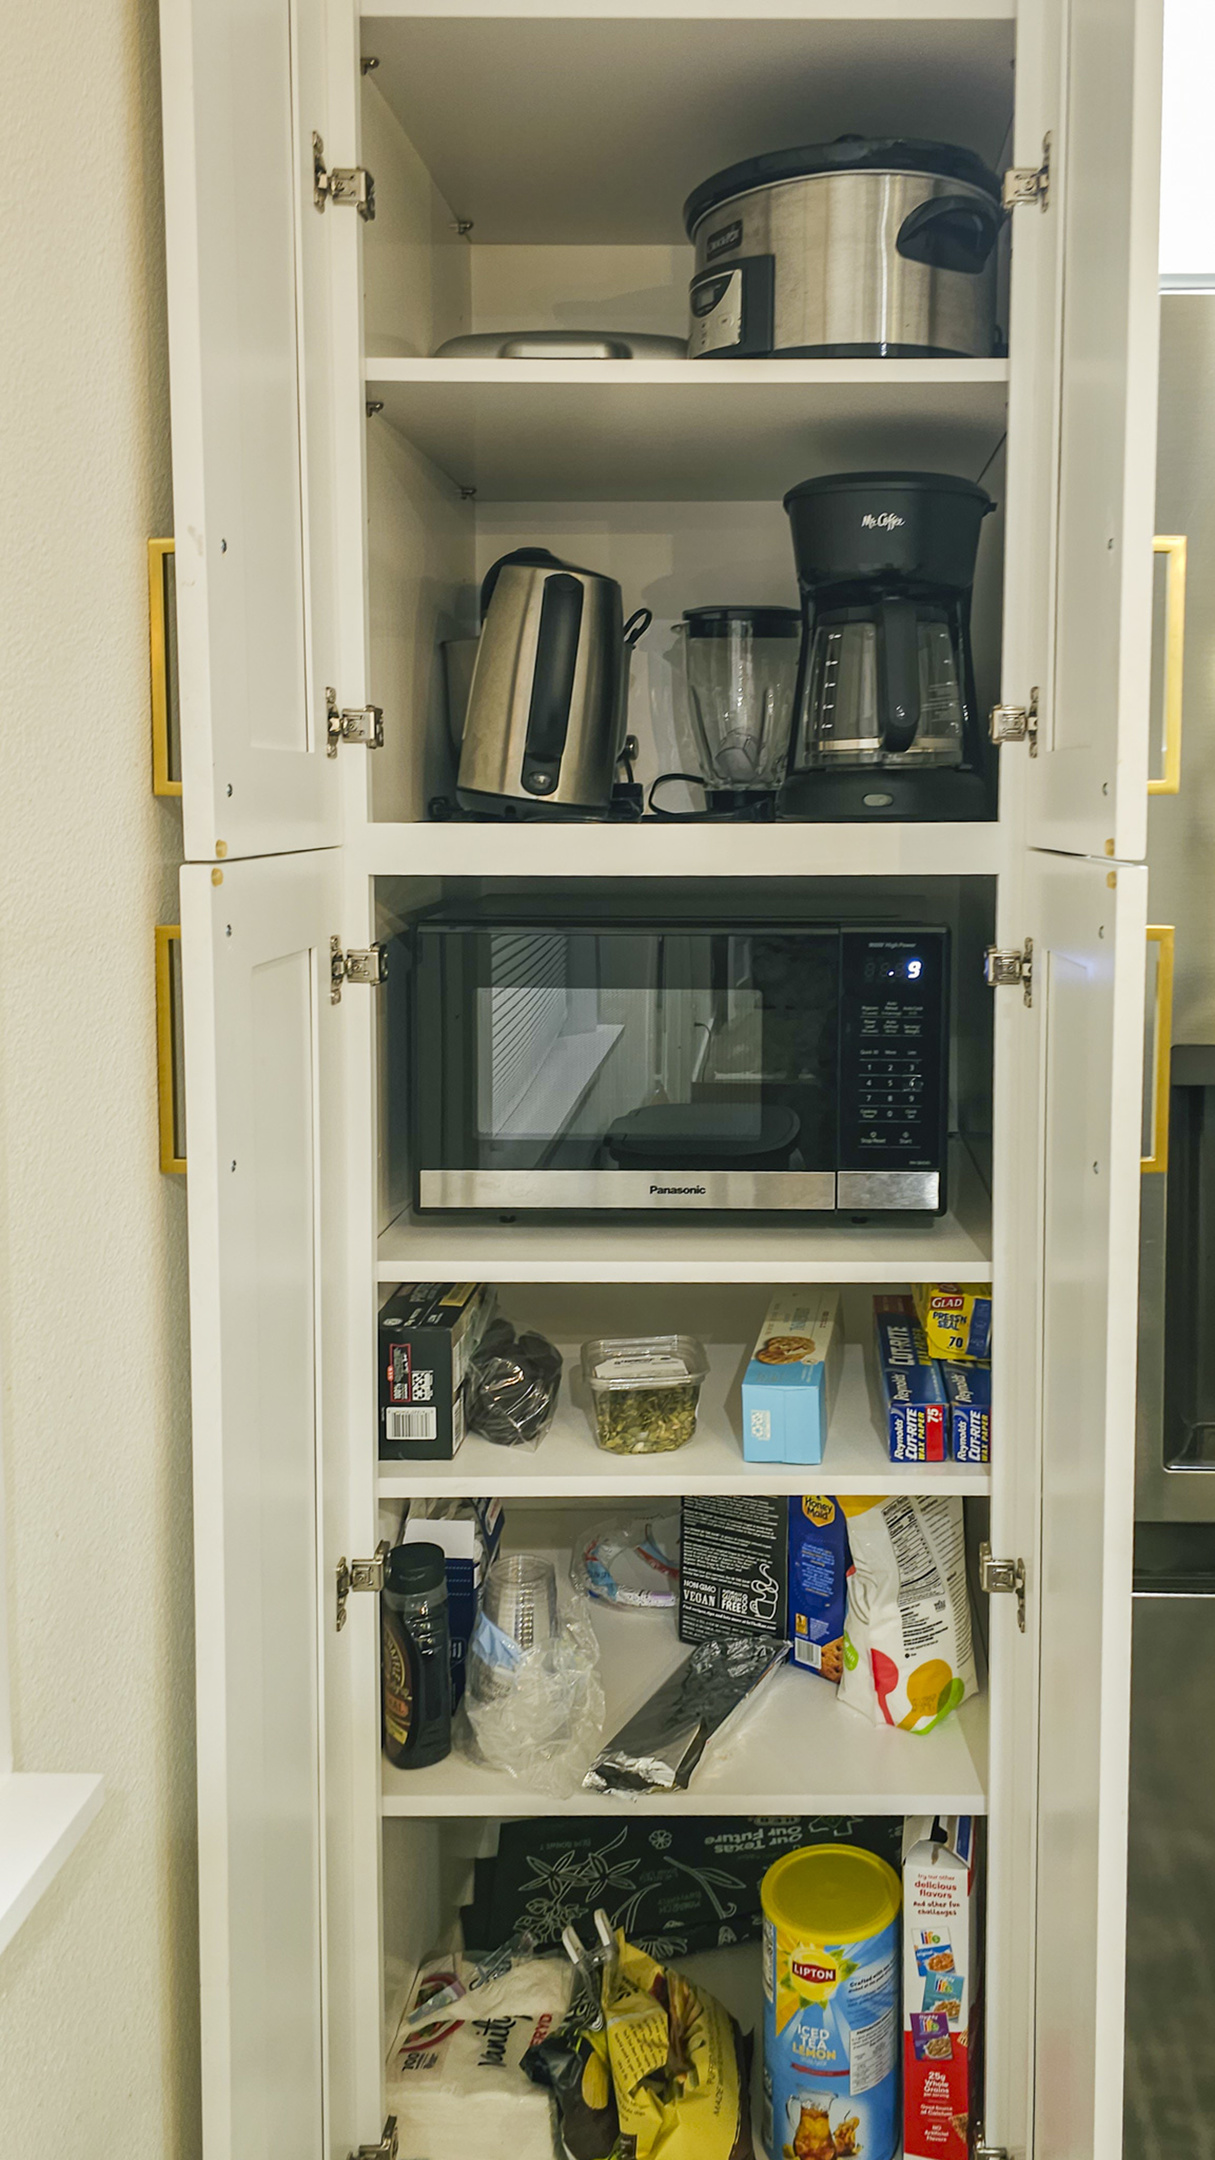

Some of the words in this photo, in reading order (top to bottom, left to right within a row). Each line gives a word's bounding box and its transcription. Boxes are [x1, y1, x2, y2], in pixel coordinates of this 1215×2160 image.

[877, 512, 906, 532] Coffee
[907, 961, 922, 979] 9
[649, 1185, 706, 1195] Panasonic
[931, 1297, 963, 1308] GLAD
[937, 1320, 960, 1331] SEAL
[886, 1325, 916, 1366] CUT-RITE
[949, 1336, 964, 1348] 70
[893, 1373, 914, 1401] Reynolds
[952, 1373, 972, 1403] Reynolds
[927, 1408, 939, 1423] 75
[905, 1408, 918, 1461] CUT-RITE
[968, 1410, 981, 1461] CUT-RITE
[981, 1414, 989, 1442] PAPER
[894, 1419, 906, 1460] Reynolds
[957, 1421, 969, 1461] Reynolds
[804, 1496, 833, 1515] Honey
[807, 1506, 828, 1520] Maid
[683, 1580, 717, 1593] NON-GMO
[683, 1589, 716, 1607] VEGAN
[721, 1600, 742, 1613] FREE
[704, 1828, 764, 1845] Future
[714, 1841, 766, 1854] Texas
[914, 1880, 957, 1891] delicious
[919, 1889, 952, 1899] flavors
[927, 1900, 947, 1908] other
[949, 1900, 960, 1908] fun
[921, 1931, 941, 1945] life
[793, 1962, 834, 1980] LIPTON
[934, 1979, 954, 1993] life
[798, 2024, 830, 2041] ICED
[920, 2019, 940, 2032] life
[472, 2015, 533, 2067] Vanity
[801, 2034, 827, 2050] TEA
[792, 2042, 836, 2060] LEMON
[924, 2079, 949, 2088] Whole
[928, 2071, 946, 2082] 25g
[923, 2086, 949, 2094] Grains
